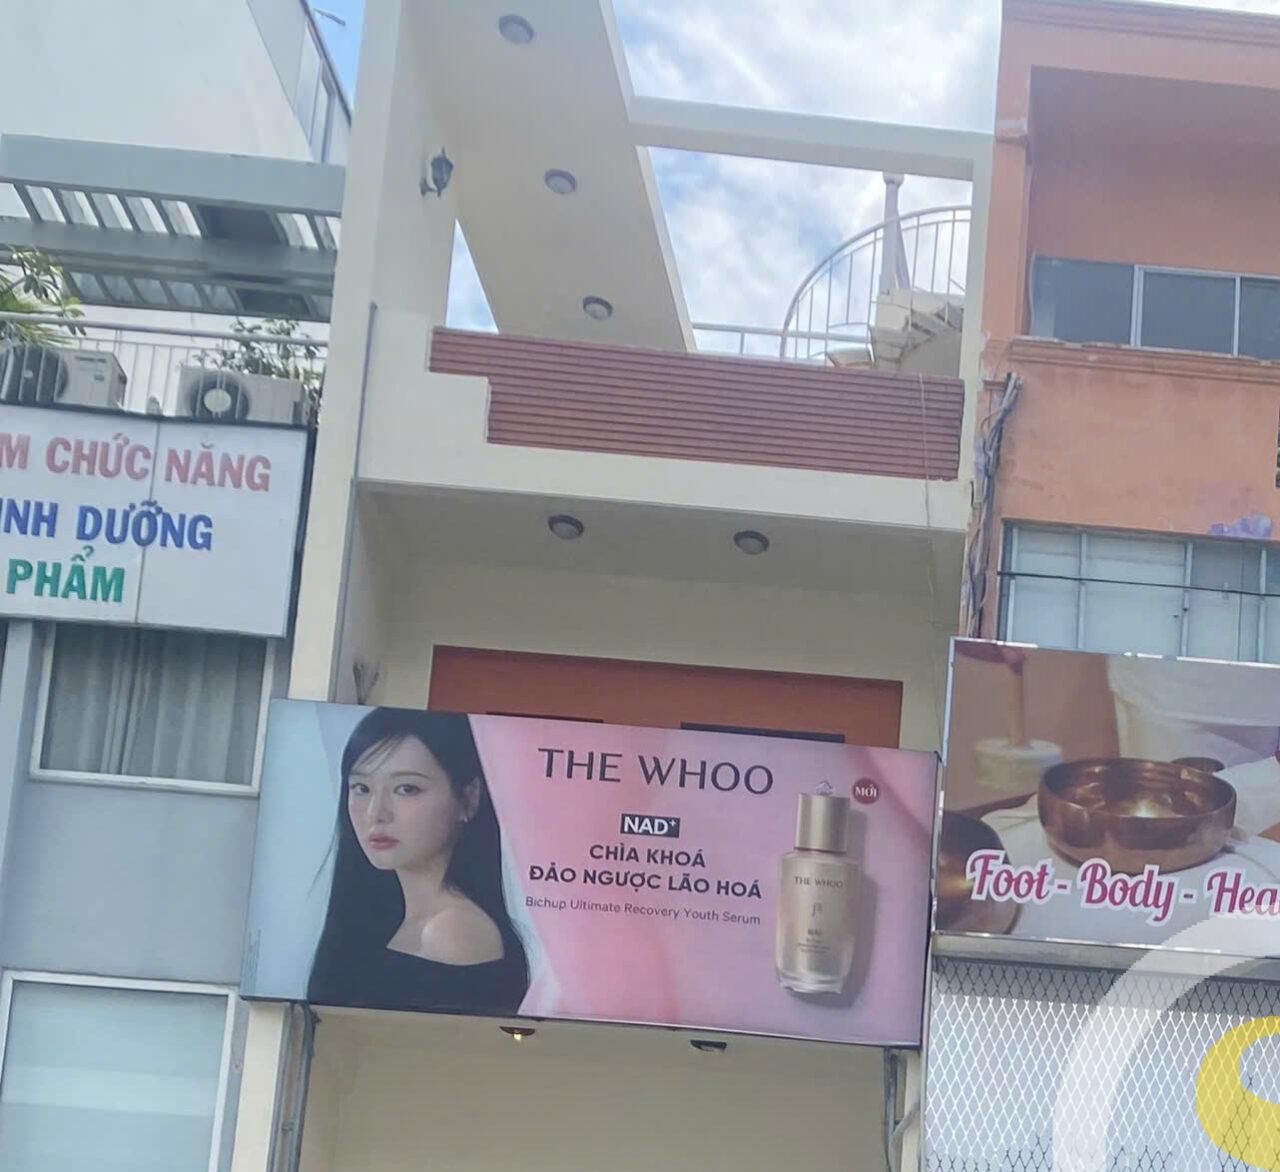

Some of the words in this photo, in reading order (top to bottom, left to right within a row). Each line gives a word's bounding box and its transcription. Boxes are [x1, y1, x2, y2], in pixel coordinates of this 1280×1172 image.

[45, 432, 151, 480] CHỨC
[164, 442, 272, 492] NĂNG
[0, 497, 58, 538] NH
[76, 500, 213, 551] DƯỠNG
[6, 545, 125, 603] PHẨM
[538, 748, 622, 783] THE
[638, 755, 774, 796] WHOO
[529, 862, 577, 883] ĐẢO
[583, 869, 661, 893] NGƯỢC
[668, 873, 710, 894] LÃO
[716, 879, 762, 900] HOÁ
[589, 843, 639, 863] CHÌA
[646, 848, 706, 868] KHOÁ
[525, 896, 566, 910] Bichup
[570, 899, 621, 914] Ultimate
[624, 903, 680, 919] Recovery
[683, 908, 719, 922] Youth
[722, 912, 761, 925] Serum
[970, 853, 1050, 900] Foot
[1080, 863, 1175, 922] Body
